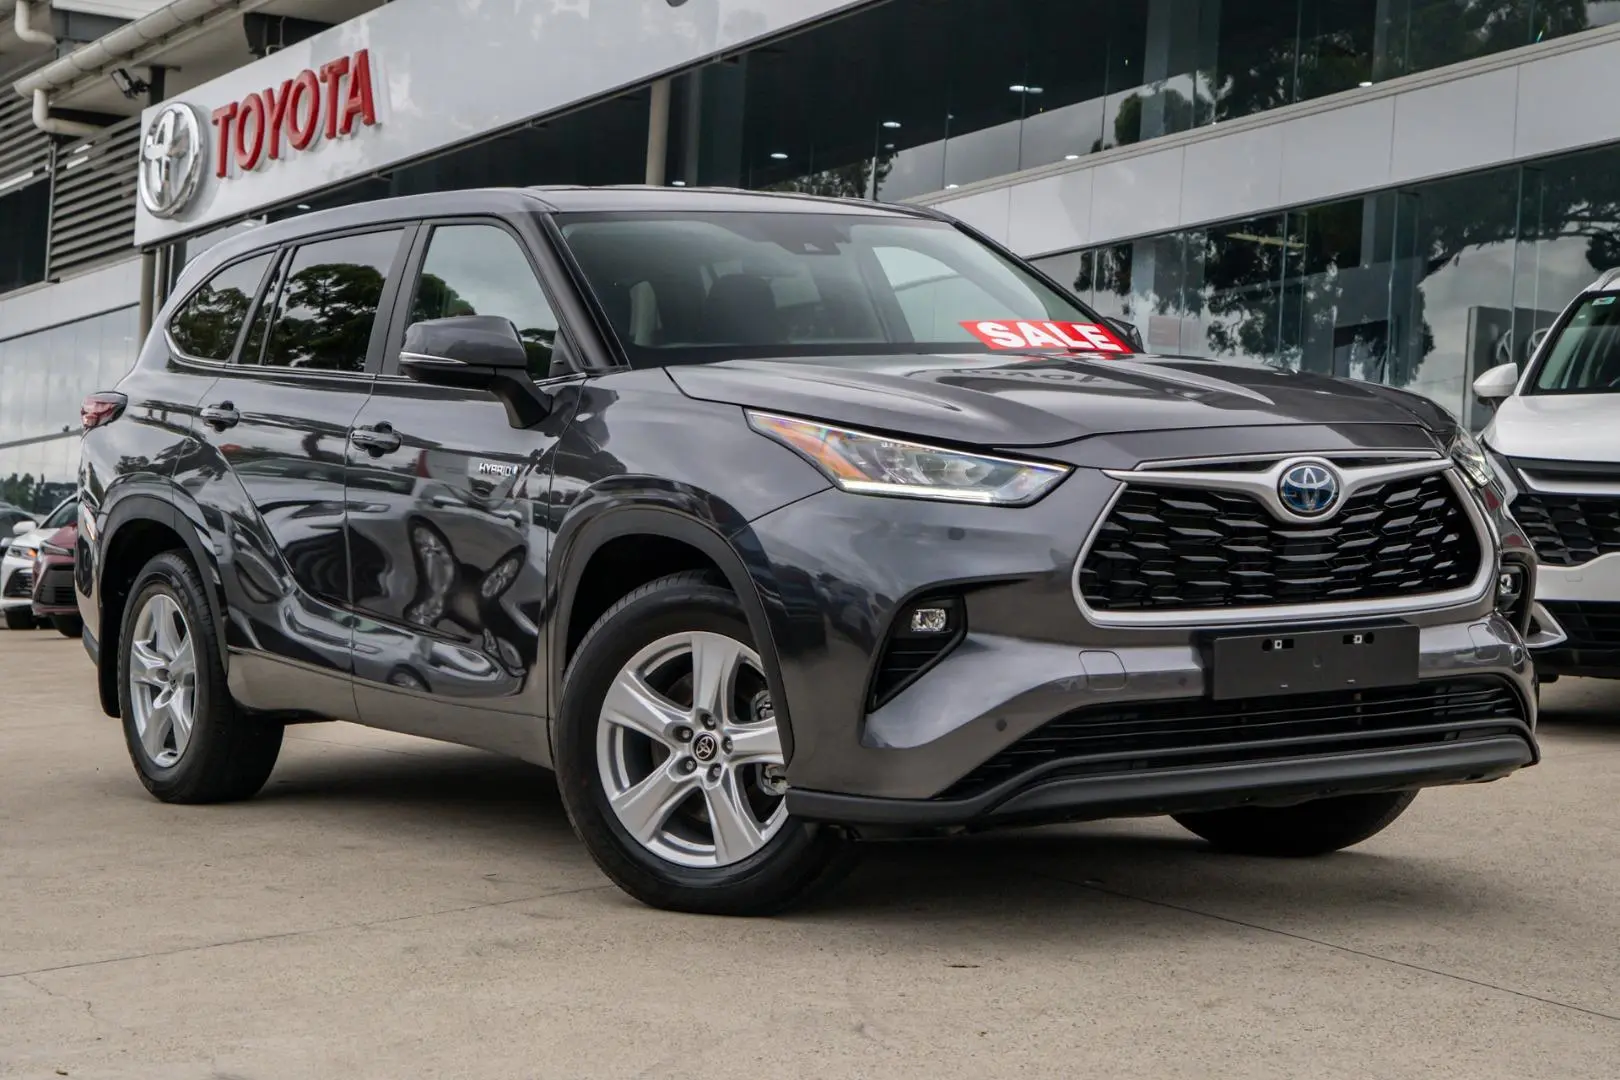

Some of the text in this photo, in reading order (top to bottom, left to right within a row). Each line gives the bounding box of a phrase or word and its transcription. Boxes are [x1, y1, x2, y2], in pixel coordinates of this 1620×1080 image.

[212, 48, 376, 178] TOYOTA
[976, 321, 1124, 352] SALE
[478, 462, 512, 477] HYBRID
